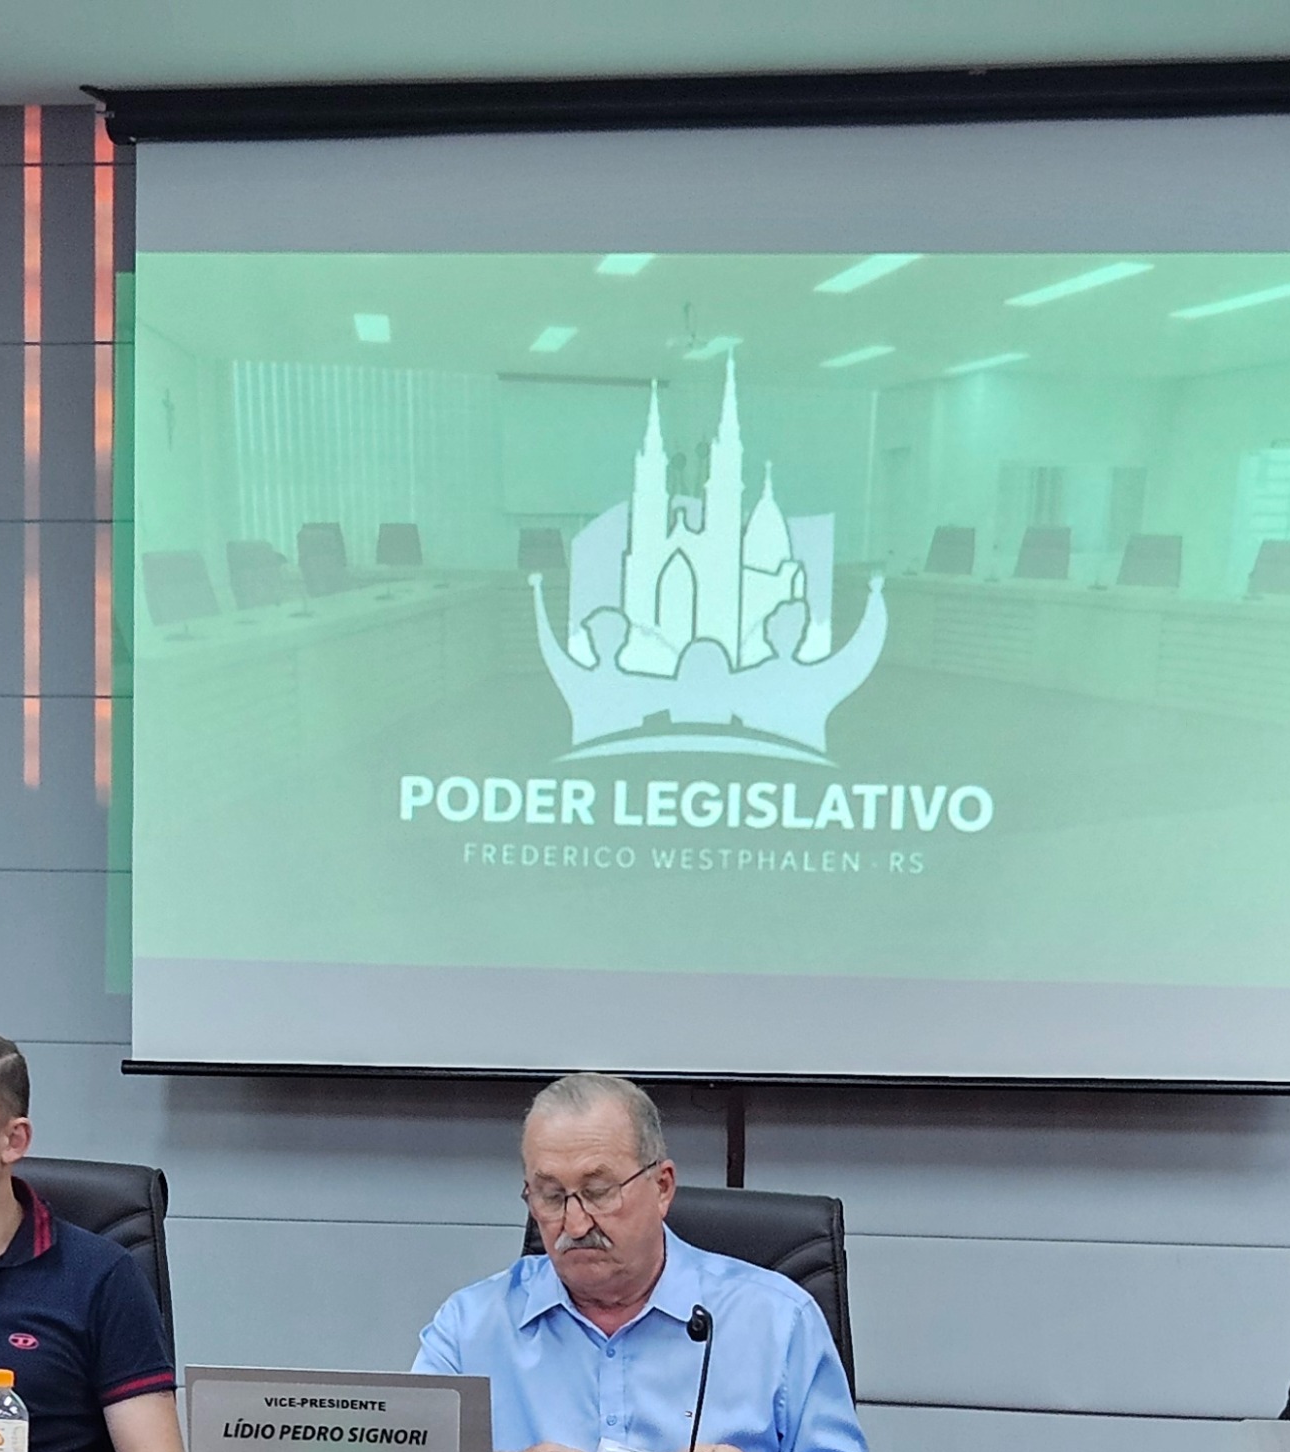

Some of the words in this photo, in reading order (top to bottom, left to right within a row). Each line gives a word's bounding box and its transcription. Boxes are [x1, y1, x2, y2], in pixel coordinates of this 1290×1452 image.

[401, 776, 596, 825] PODER
[614, 780, 993, 832] LEGISLATIVO
[464, 842, 635, 868] FREDERICO
[652, 847, 860, 871] WESTPHALEN
[890, 852, 924, 874] RS
[264, 1397, 386, 1411] VICE-PRESIDENTE
[223, 1418, 275, 1440] LÍDIO
[279, 1425, 343, 1442] PEDRO
[348, 1428, 428, 1446] SIGNORI
